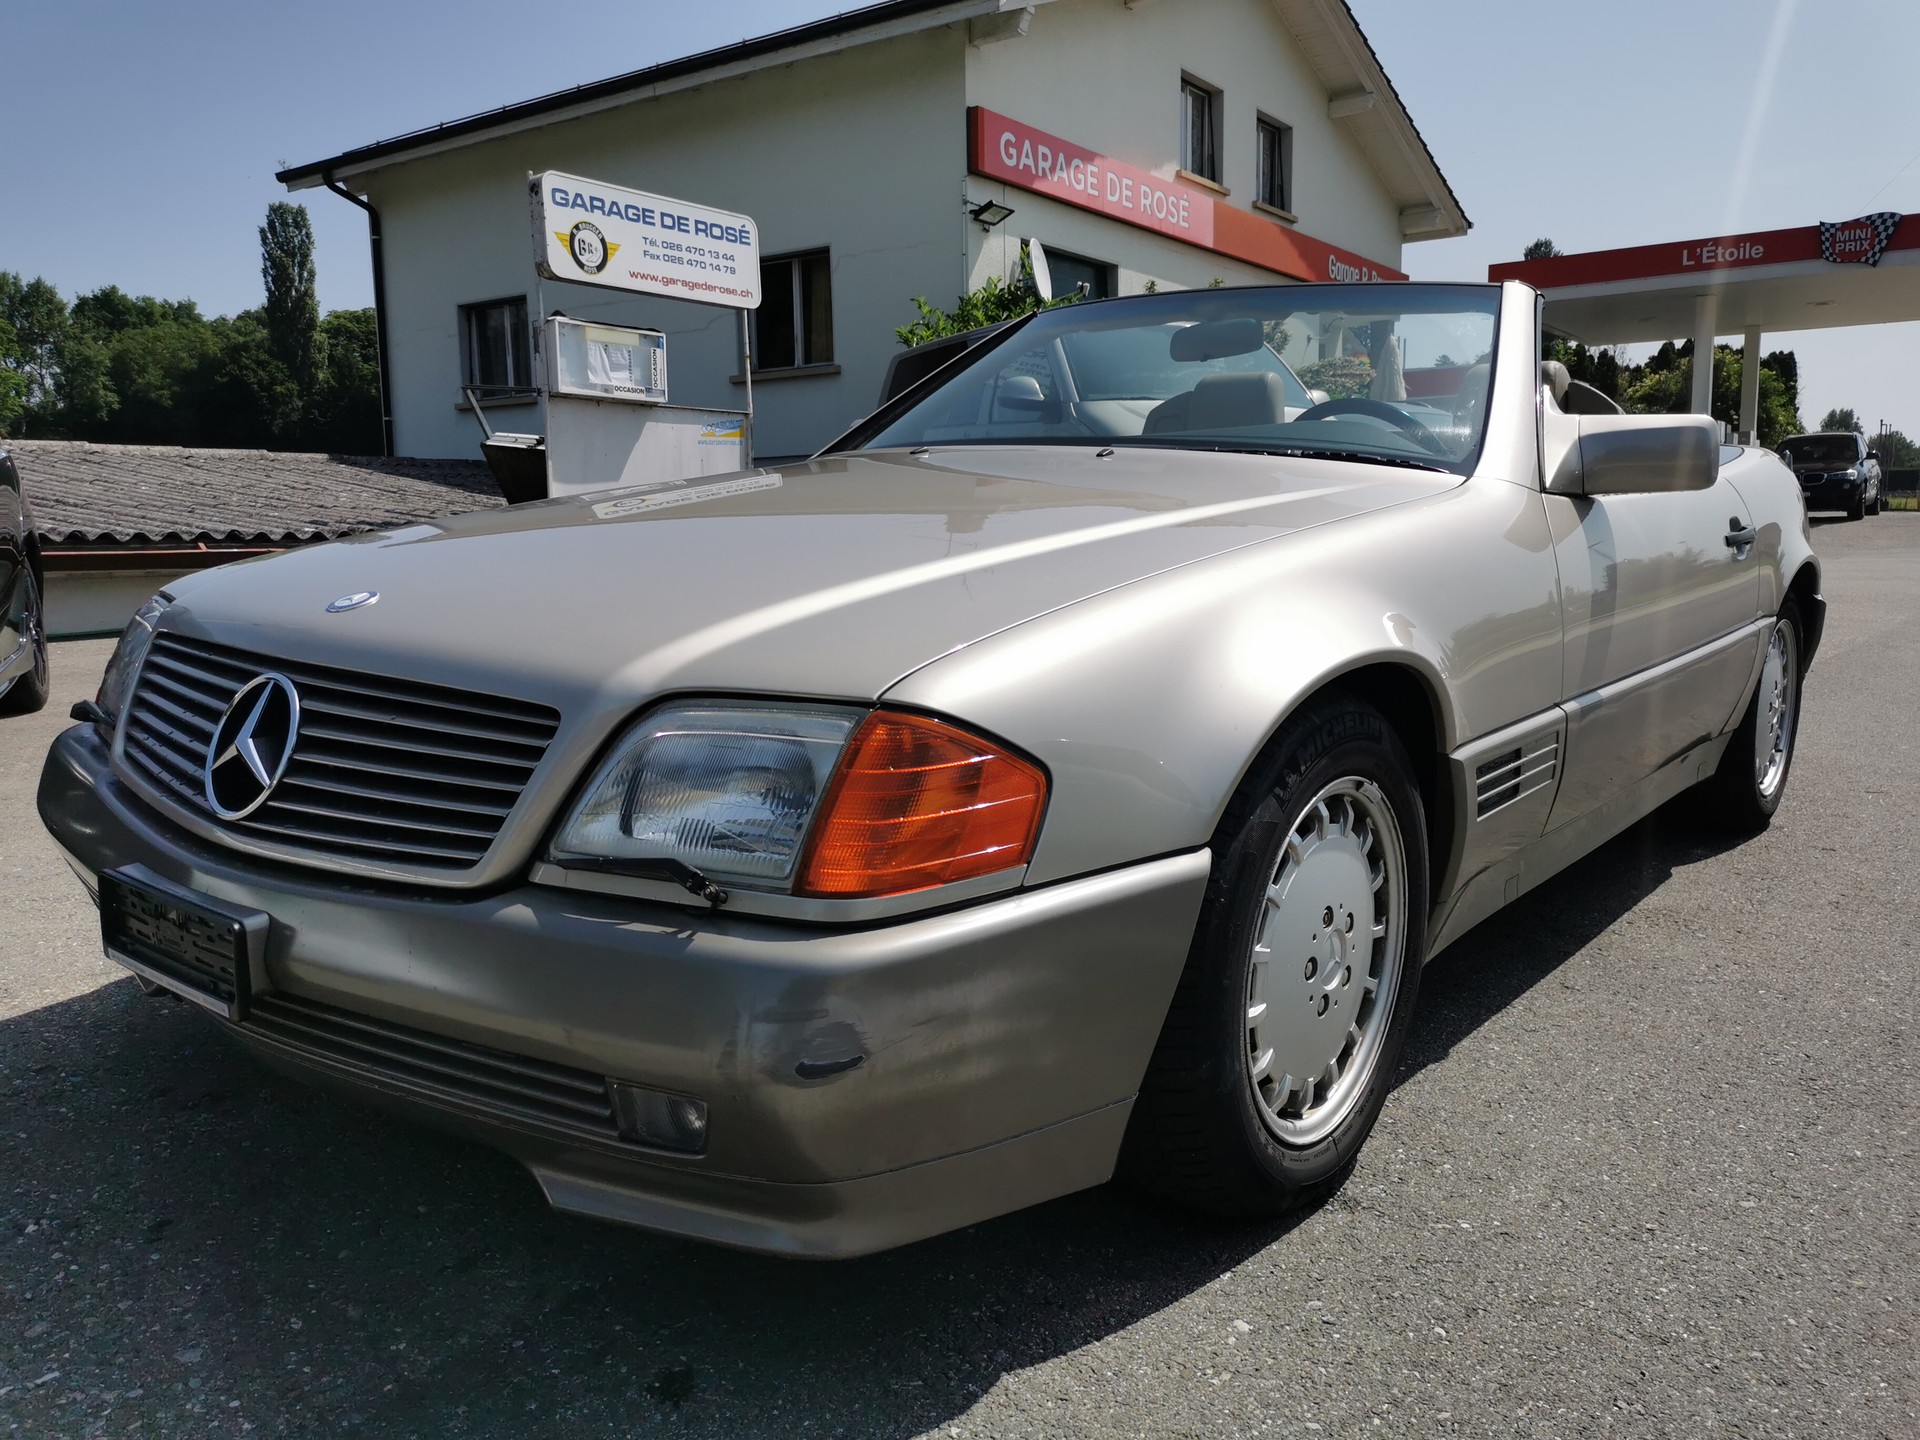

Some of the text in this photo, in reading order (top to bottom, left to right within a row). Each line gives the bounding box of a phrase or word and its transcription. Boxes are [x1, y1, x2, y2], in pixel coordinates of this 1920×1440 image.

[1000, 131, 1190, 229] GARAGE DE ROSÉ
[551, 187, 751, 246] GARAGE DE ROSÉ
[1835, 239, 1871, 254] PRIX
[1836, 227, 1872, 243] MINI
[641, 236, 735, 263] Tél. 026 470 13 44
[643, 250, 736, 275] Fax 026 470 14 79
[1682, 241, 1764, 266] L'Étoile
[628, 270, 753, 299] www.garagederose.ch
[614, 385, 645, 395] OCCASION
[1296, 712, 1385, 774] MICHELIN
